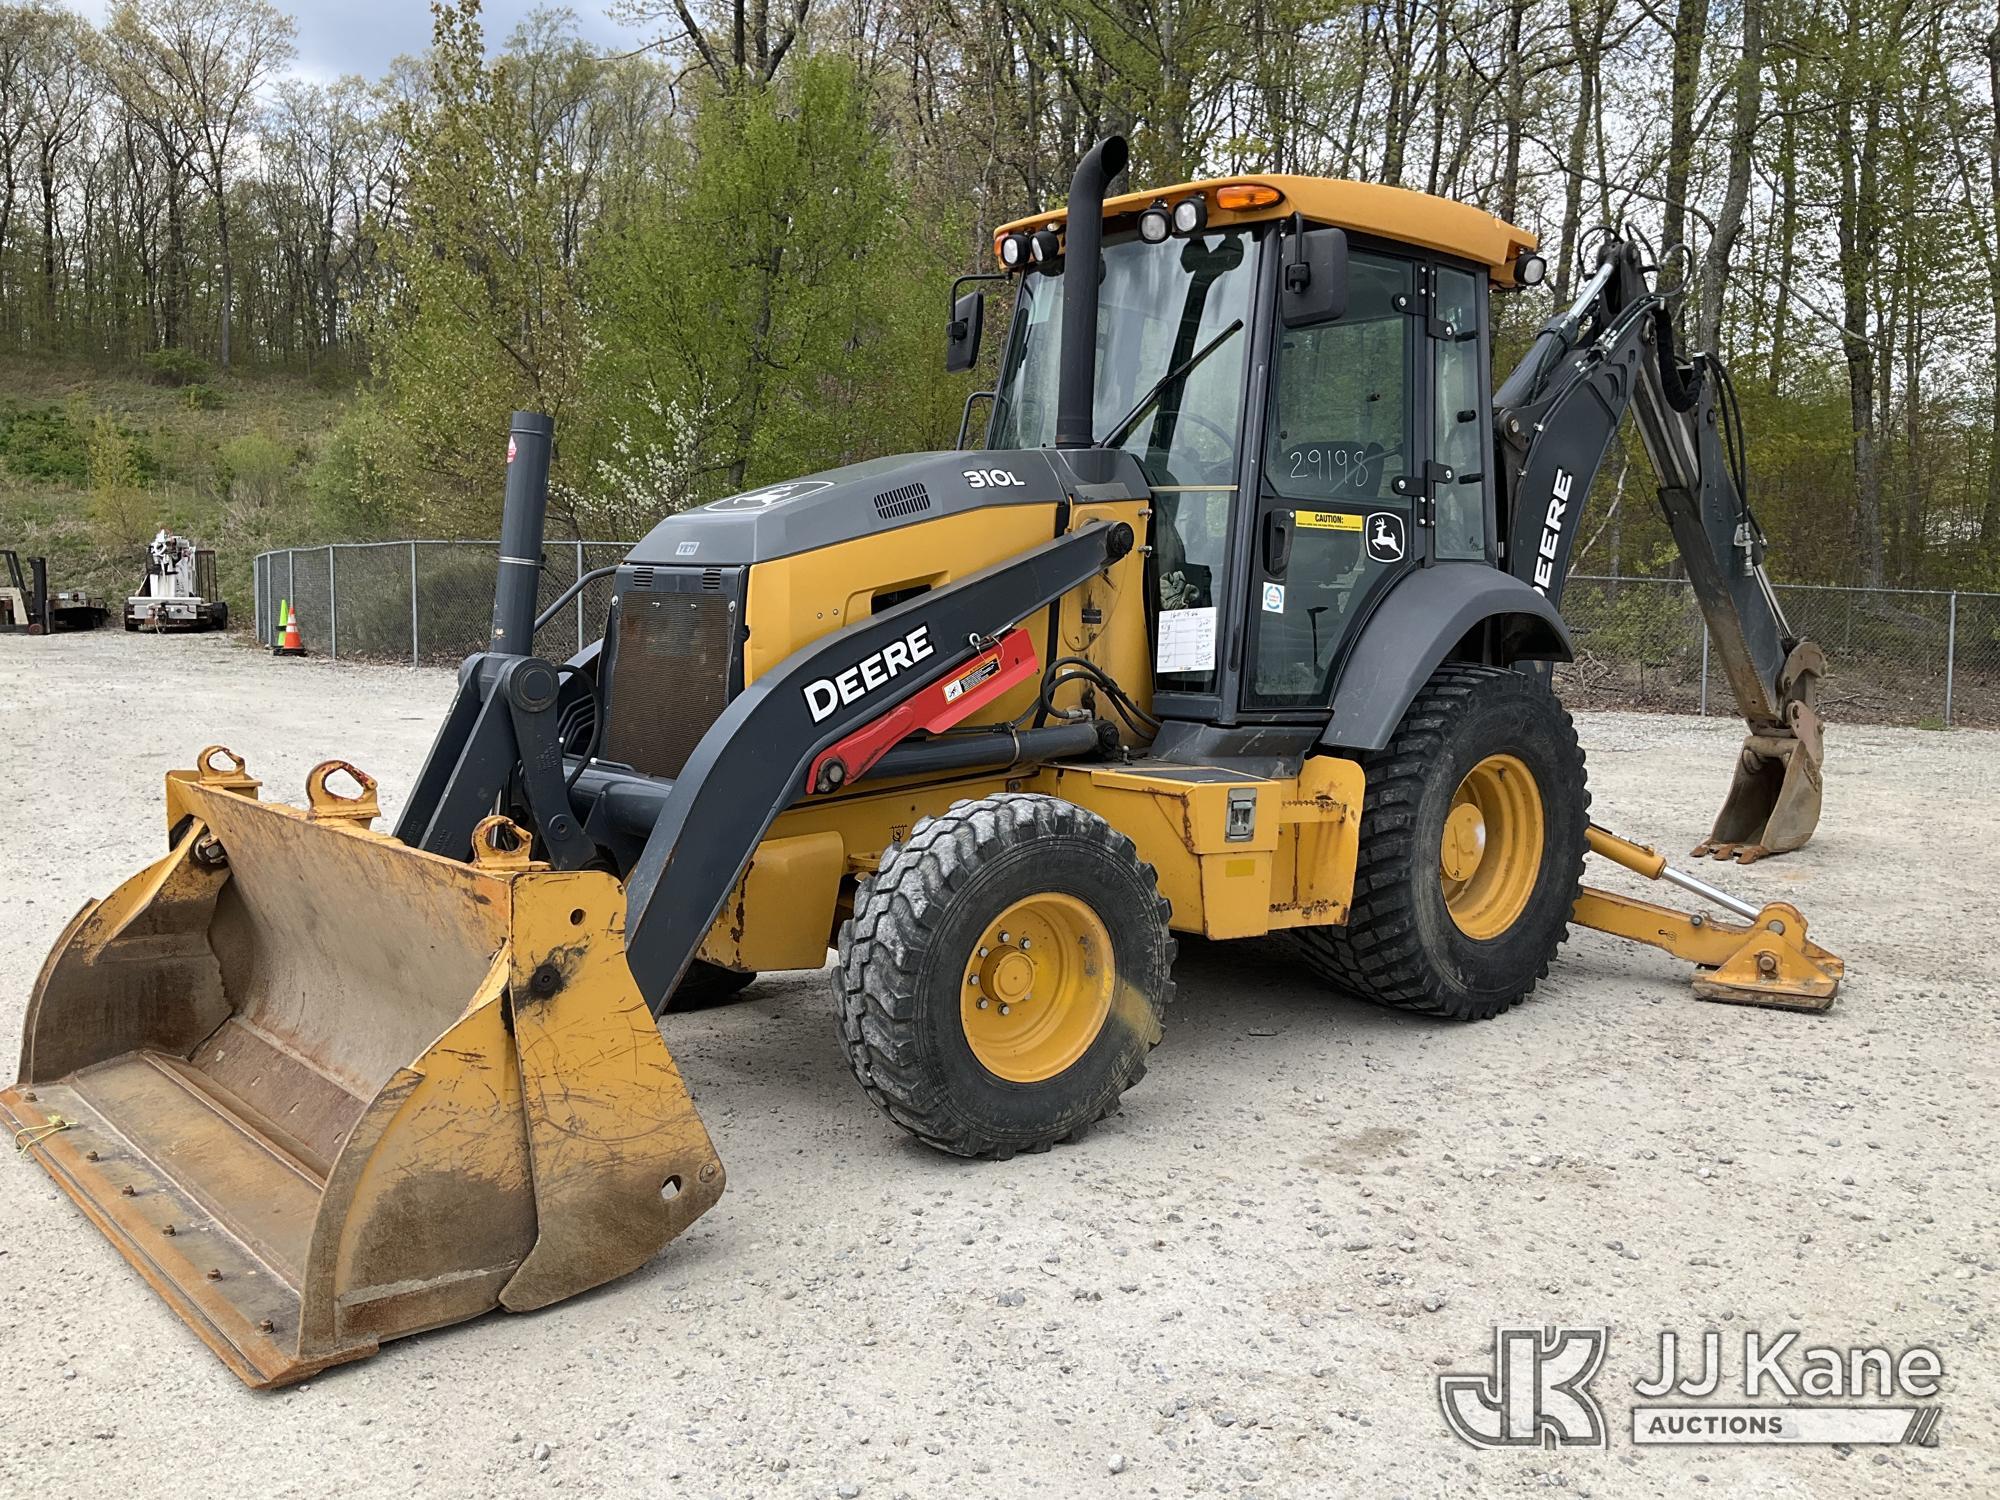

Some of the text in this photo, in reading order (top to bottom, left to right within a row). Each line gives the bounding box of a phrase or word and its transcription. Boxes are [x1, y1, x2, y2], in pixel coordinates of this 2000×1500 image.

[963, 469, 1026, 488] 310L
[1290, 449, 1369, 487] 29198
[1314, 513, 1344, 524] CAUTION:
[1532, 468, 1573, 597] EERE
[803, 625, 934, 723] DEERE
